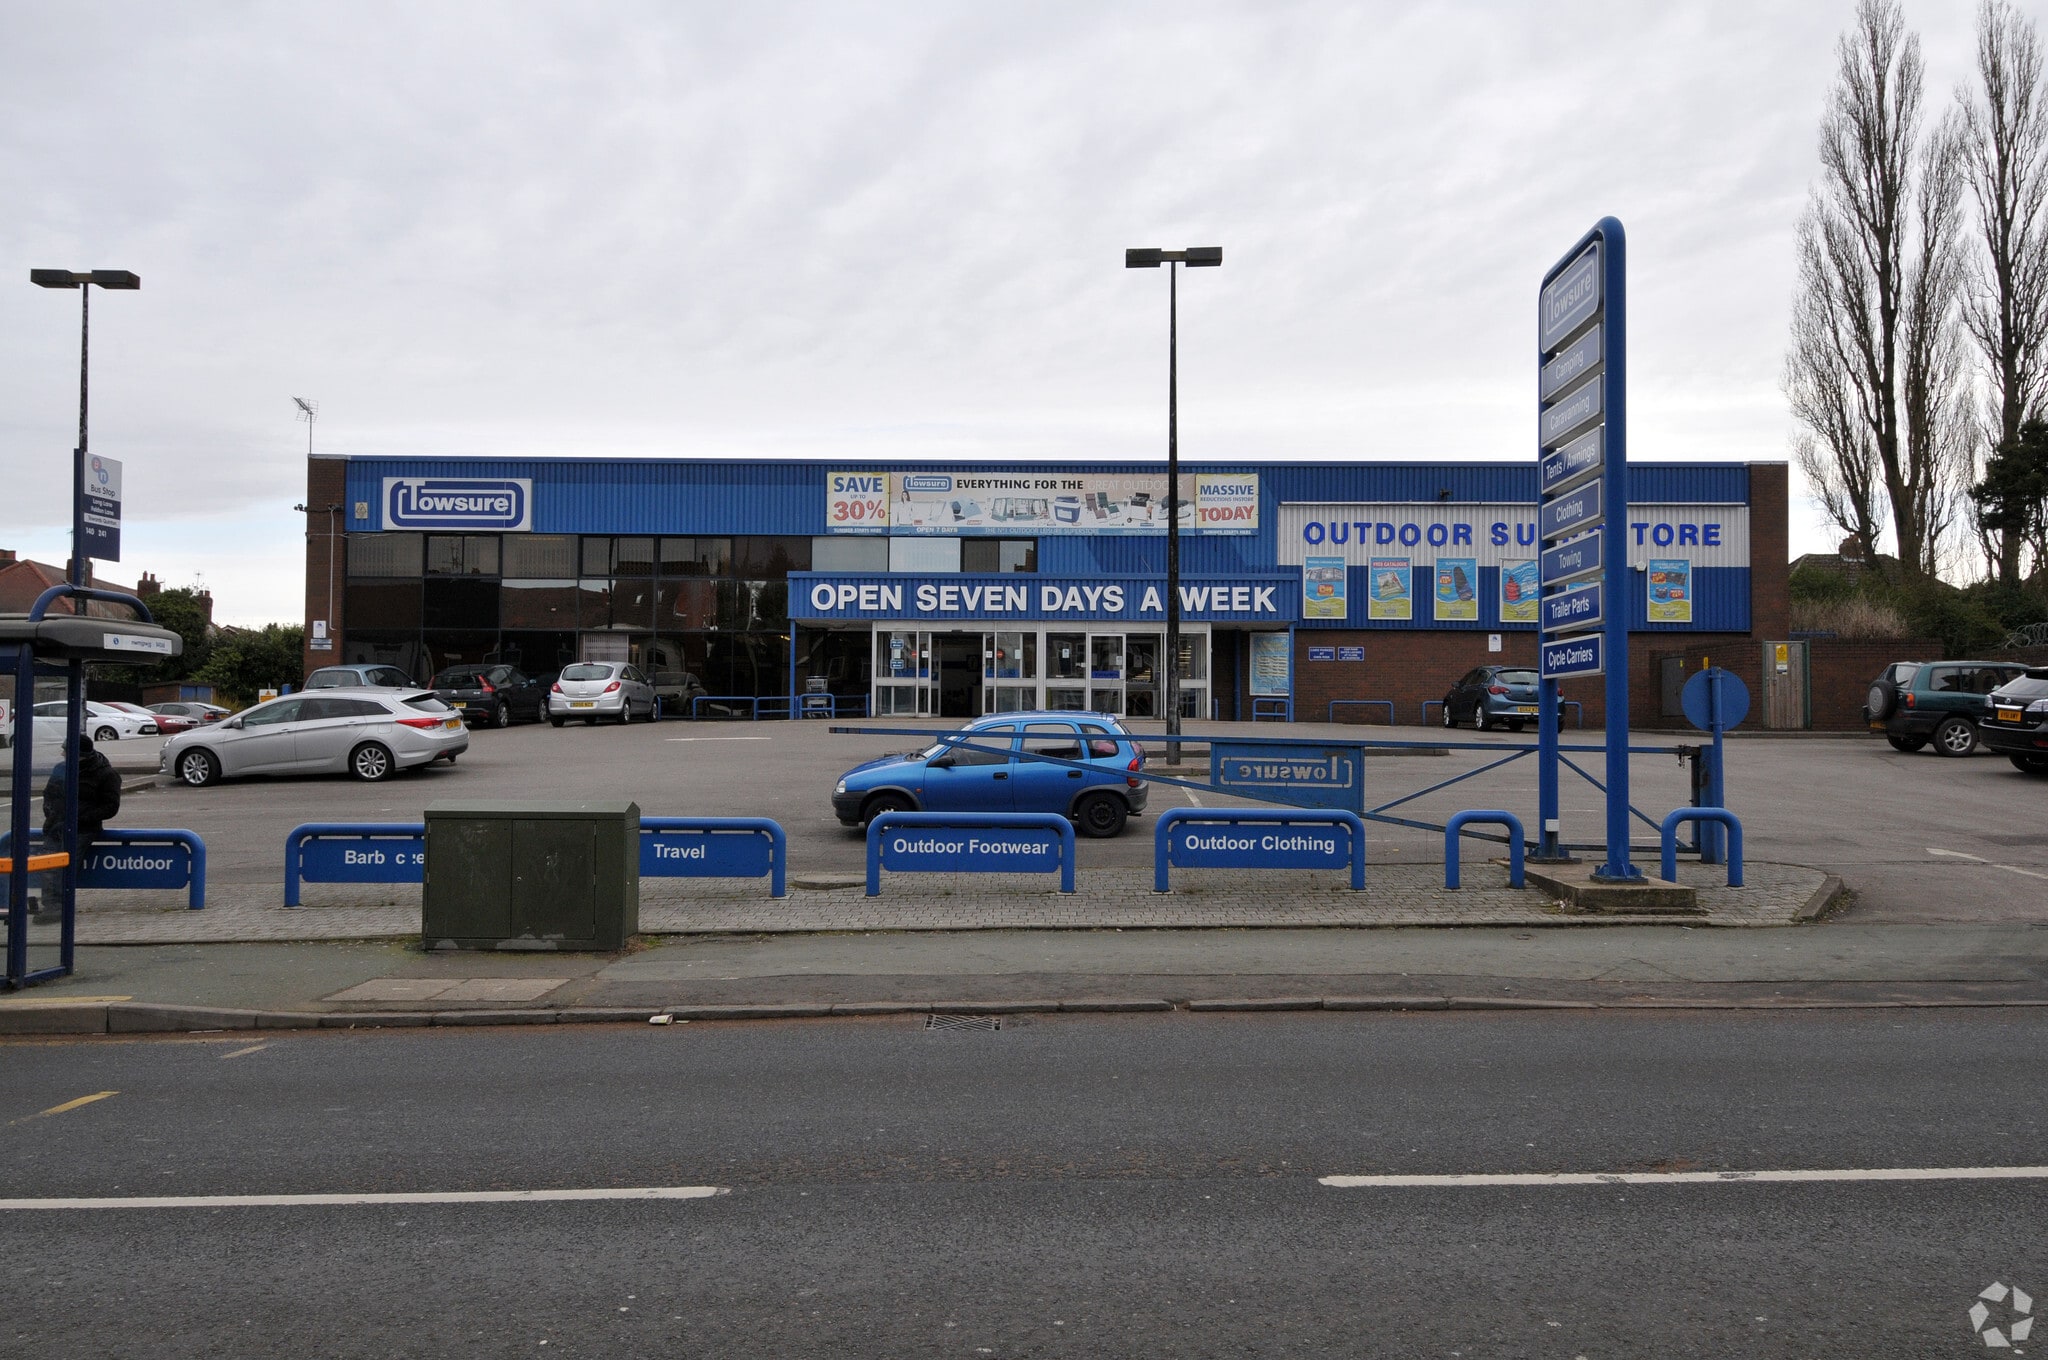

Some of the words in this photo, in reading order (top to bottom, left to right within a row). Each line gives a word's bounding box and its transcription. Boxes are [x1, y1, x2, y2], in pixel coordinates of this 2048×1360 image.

[1548, 274, 1592, 322] Towsure
[1555, 350, 1584, 379] Camping
[1550, 395, 1590, 430] Caravanning
[1546, 460, 1562, 480] Tents
[1567, 442, 1595, 468] Awnings
[90, 484, 101, 494] Bus
[102, 487, 116, 498] Stop
[833, 477, 883, 493] SAVE
[909, 476, 946, 487] Towsure
[957, 480, 1030, 489] EVERYTHING
[1034, 480, 1057, 489] FOR
[1062, 480, 1083, 489] THE
[1088, 480, 1119, 490] GREAT
[1123, 480, 1184, 490] OUTDOOS
[1200, 485, 1254, 495] MASSIVE
[402, 480, 510, 512] Towsure
[833, 500, 885, 521] 30%
[1199, 504, 1254, 522] TODAY
[1556, 500, 1583, 522] Clothing
[1304, 522, 1472, 547] OUTDOOR
[1491, 522, 1721, 547] SUTORE
[1558, 550, 1582, 570] Towing
[811, 584, 901, 611] OPEN
[916, 584, 1026, 611] SEVEN
[1042, 585, 1124, 612] DAYS
[1140, 586, 1163, 611] A
[1178, 586, 1277, 612] WEEK
[1551, 601, 1571, 619] Trailer
[1572, 597, 1590, 614] Parts
[1548, 650, 1566, 670] Cycle
[1567, 646, 1593, 665] Carriers
[654, 844, 706, 860] Travel
[893, 838, 964, 854] Outdoor
[969, 839, 1049, 855] Footwear
[1186, 835, 1256, 850] Outdoor
[1262, 836, 1335, 854] Clothing
[103, 856, 173, 870] Outdoor
